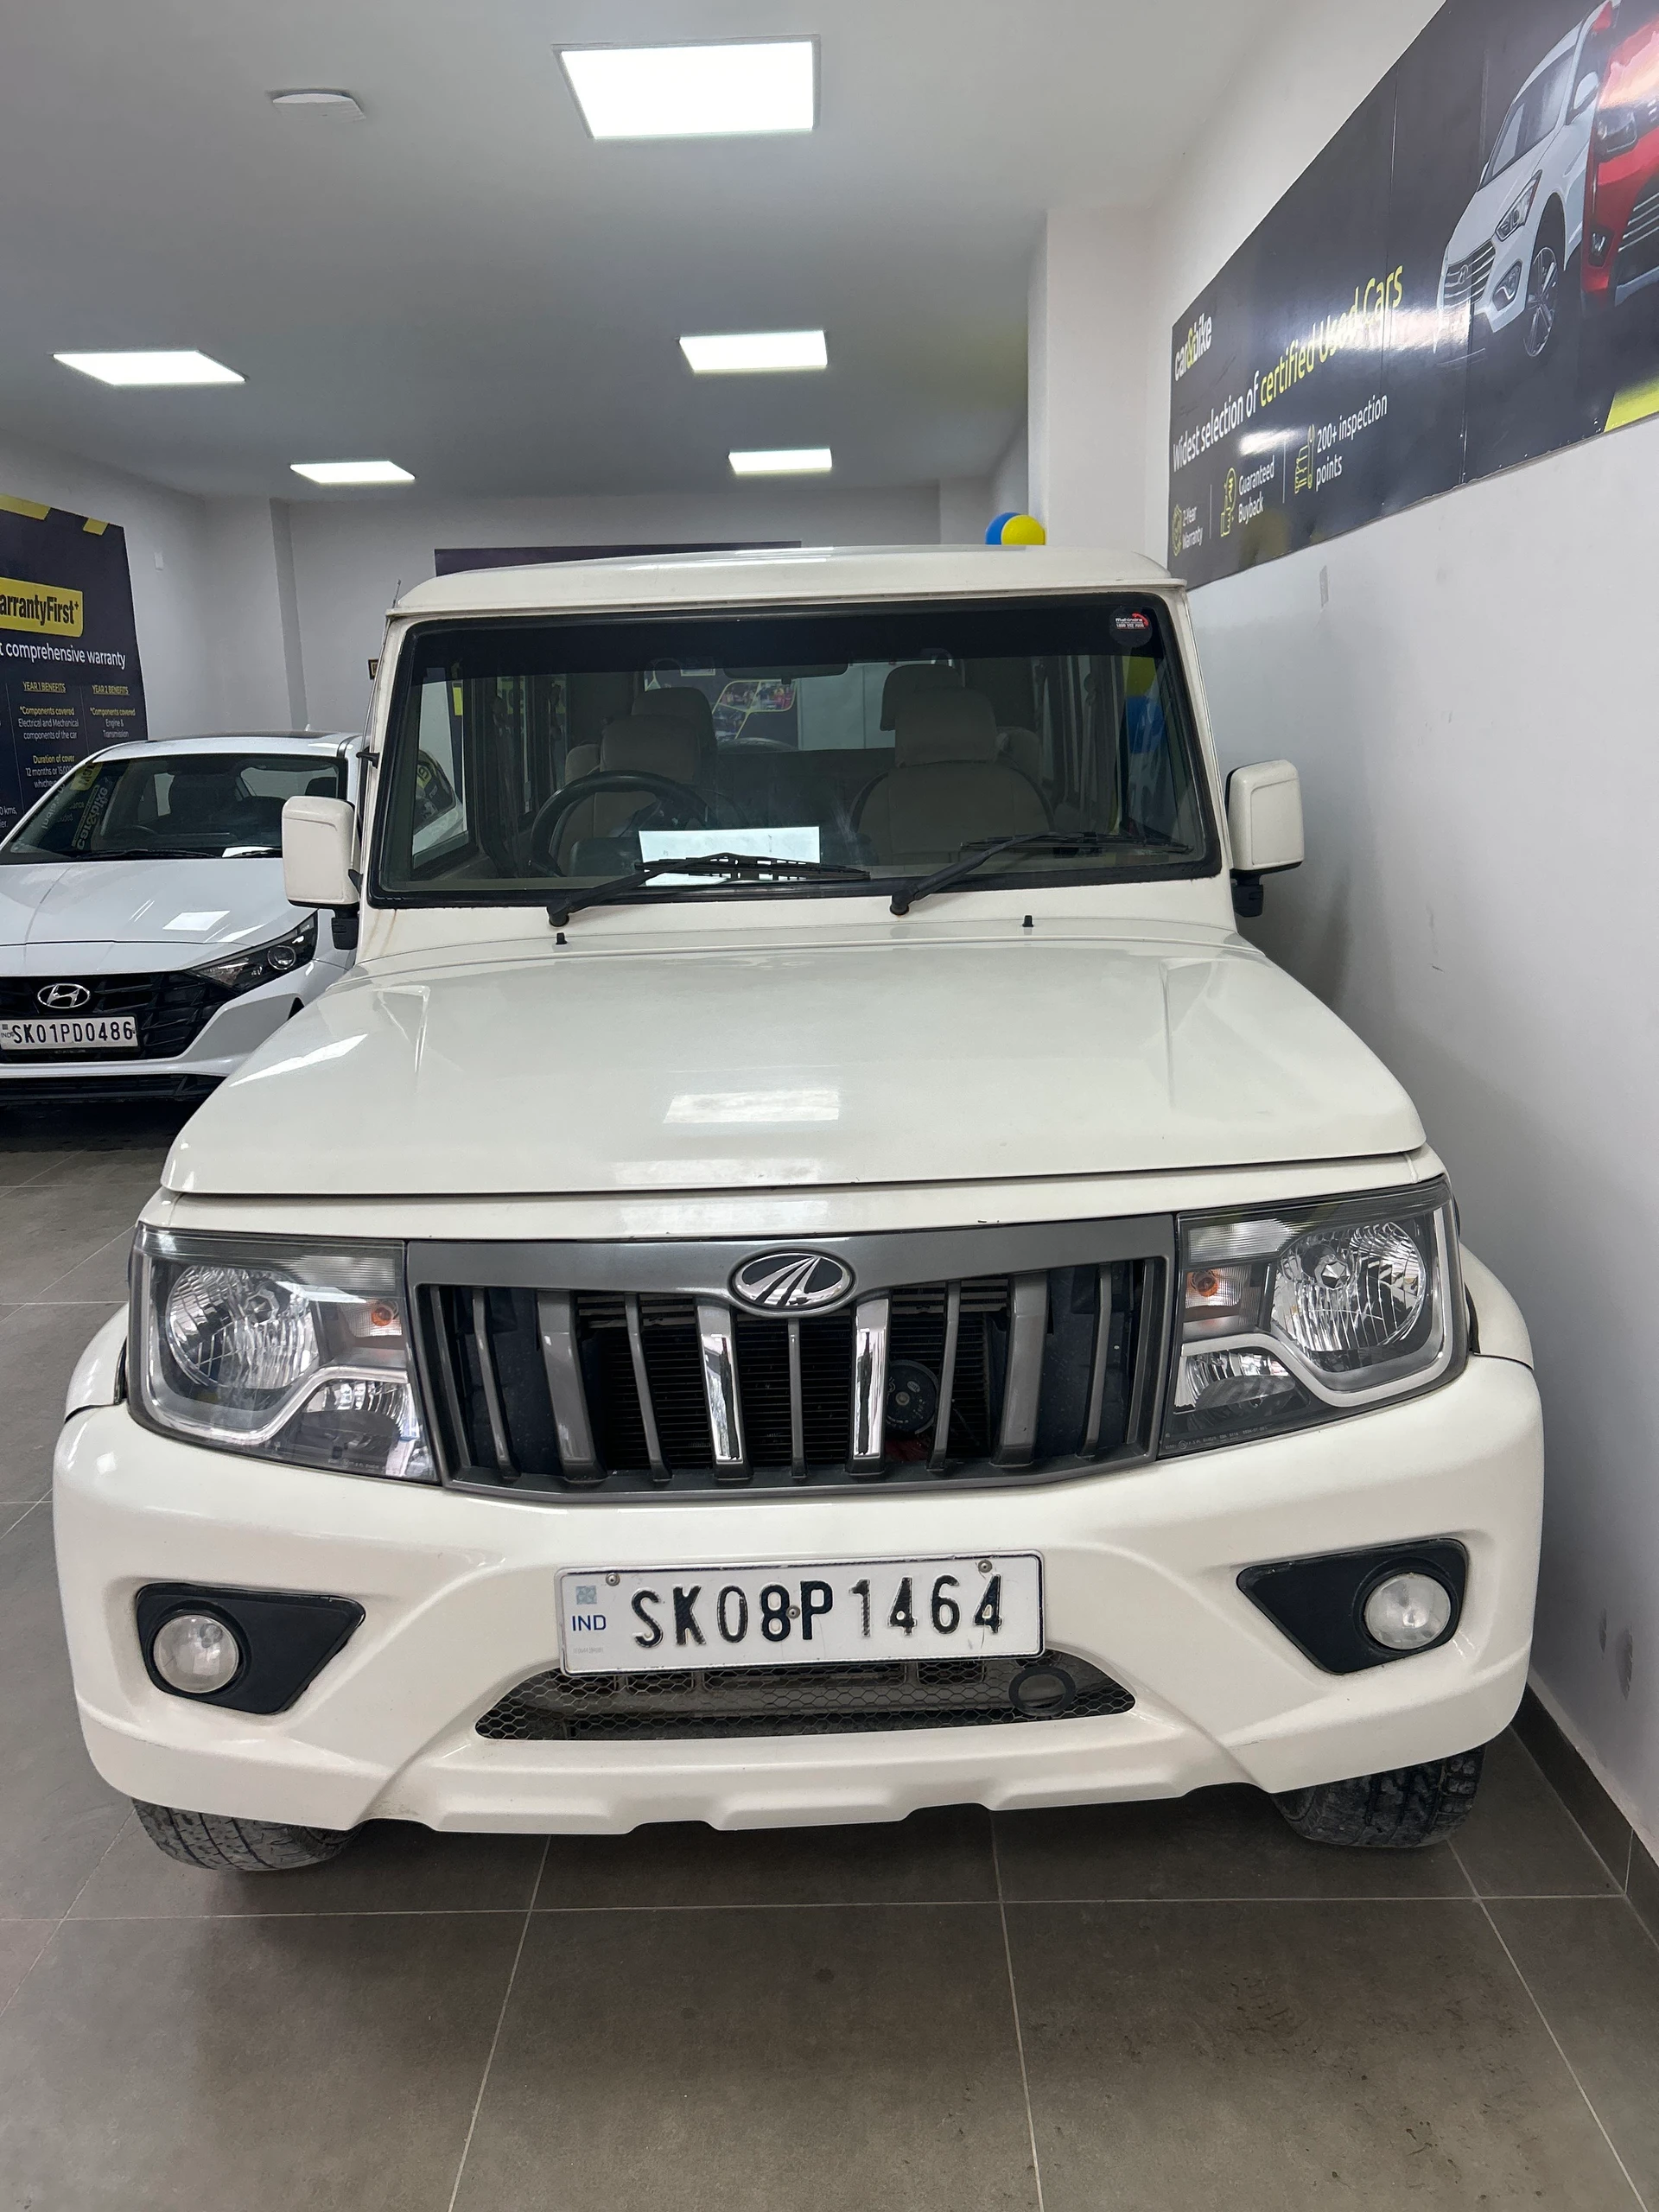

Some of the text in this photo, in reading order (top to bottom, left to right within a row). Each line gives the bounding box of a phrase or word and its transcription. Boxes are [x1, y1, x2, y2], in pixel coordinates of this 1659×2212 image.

[1174, 313, 1212, 381] car&bike
[1173, 265, 1403, 472] Widest selection of certified Used Cars
[1317, 394, 1387, 454] 200+ inspection
[1238, 454, 1274, 496] Guaranteed
[1315, 454, 1342, 492] points
[1238, 491, 1263, 524] Buyback
[1182, 525, 1203, 550] Warranty
[0, 594, 79, 626] arrantyFirst+
[6, 642, 86, 663] comprehensive
[86, 650, 126, 670] warranty
[22, 682, 38, 691] YEAR
[41, 683, 67, 692] BENEFITS
[92, 685, 105, 694] YEAR
[108, 685, 130, 695] BENEFITS
[56, 707, 75, 715] covered
[18, 718, 79, 728] Electrical and Mechanical
[103, 729, 130, 739] Transmission
[105, 718, 121, 729] Engine
[23, 731, 55, 741] components
[55, 730, 60, 740] of
[60, 730, 69, 739] the
[33, 754, 56, 764] Duration
[55, 753, 61, 763] of
[32, 766, 52, 777] months
[12, 1021, 133, 1044] SK01PD0486
[572, 1614, 607, 1631] IND
[631, 1573, 1003, 1649] SK08P1464
